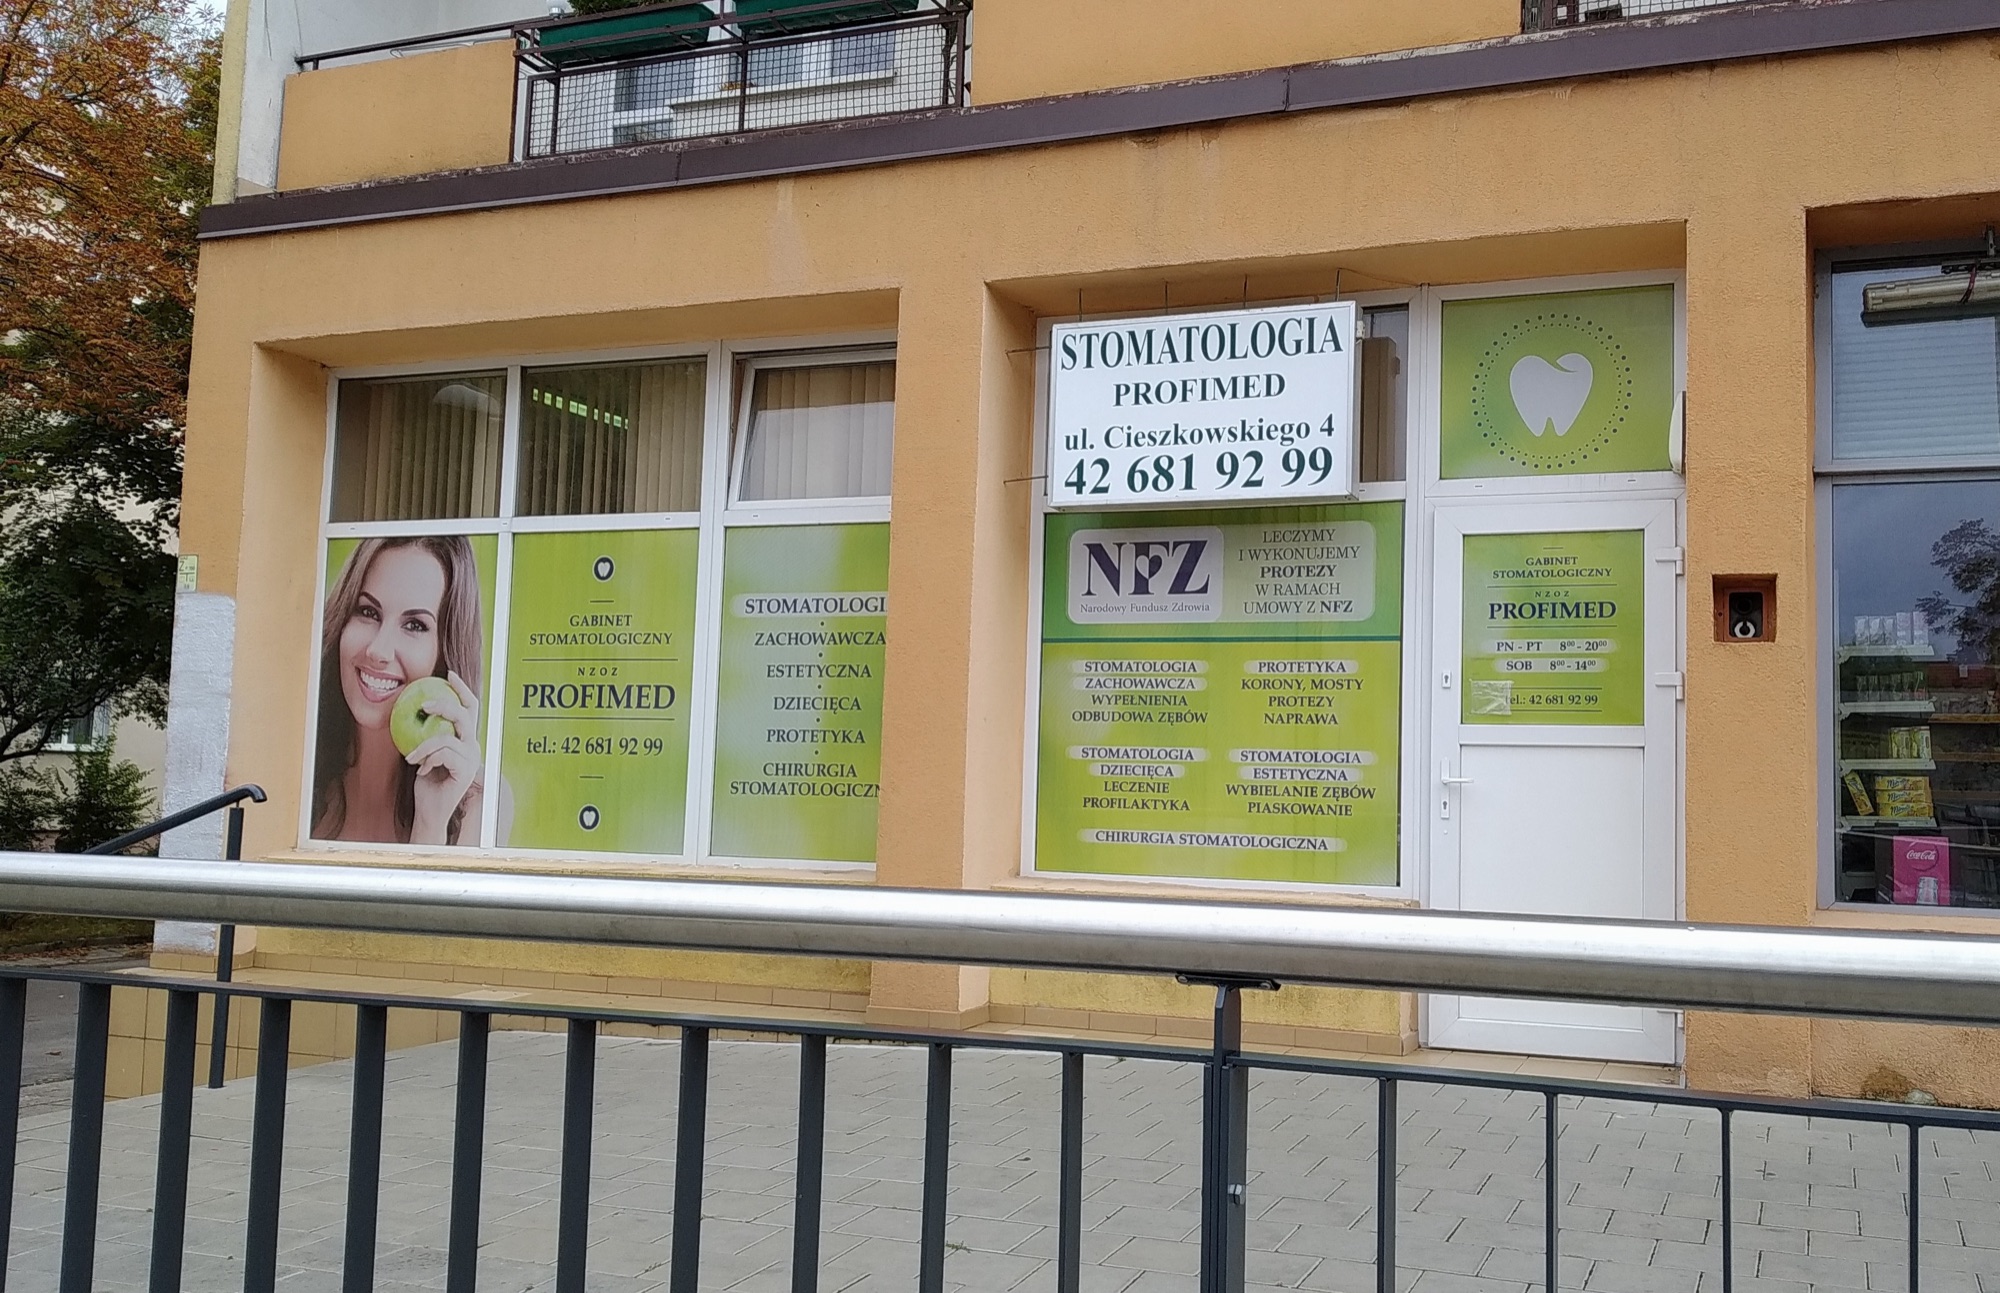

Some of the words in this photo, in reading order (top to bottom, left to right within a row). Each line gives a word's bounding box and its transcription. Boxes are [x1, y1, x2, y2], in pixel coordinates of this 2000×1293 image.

[1061, 315, 1344, 371] STOMATOLOGIA
[1113, 373, 1286, 407] PROFIMED
[1065, 428, 1095, 450] ul.
[1104, 418, 1310, 449] Cieszkowskiego
[1319, 413, 1335, 438] 4
[1064, 458, 1111, 495] 42
[1127, 453, 1198, 494] 681
[1215, 450, 1265, 490] 92
[1281, 446, 1334, 487] 99
[1262, 529, 1336, 543] LECZYMY
[1238, 549, 1244, 561] I
[1247, 546, 1361, 561] WYKONUJEMY
[1081, 540, 1210, 597] NFZ
[1525, 556, 1578, 567] GABINET
[1260, 564, 1337, 579] PROTEZY
[1492, 568, 1613, 579] STOMATOLOGICZNY
[1255, 583, 1270, 596] W
[1273, 582, 1341, 596] RAMACH
[745, 597, 888, 615] STOMATOLOGI
[1080, 602, 1127, 615] Narodowy
[1130, 602, 1169, 613] Fundusz
[1171, 602, 1210, 613] Zdrowia
[1243, 600, 1303, 615] UMOWY
[1306, 601, 1316, 613] Z
[1319, 600, 1354, 614] NFZ
[1488, 601, 1617, 620] PROFIMED
[569, 614, 633, 628] GABINET
[529, 632, 673, 646] STOMATOLOGICZNY
[754, 631, 887, 646] ZACHOWAWCZA
[1496, 641, 1514, 652] PN
[1526, 641, 1543, 651] PT
[766, 664, 872, 679] ESTETYCZNA
[1084, 660, 1197, 673] STOMATOLOGIA
[1258, 661, 1347, 673] PROTETYKA
[1506, 660, 1533, 671] SOB
[1085, 677, 1196, 690] ZACHOWAWCZA
[1241, 678, 1306, 693] KORONY,
[1310, 678, 1364, 691] MOSTY
[521, 684, 676, 710] PROFIMED
[1091, 694, 1188, 706] WYPEŁNIENIA
[1268, 695, 1335, 708] PROTEZY
[1528, 695, 1543, 706] 42
[1545, 694, 1564, 706] 681
[1568, 694, 1582, 706] 92
[1584, 694, 1599, 706] 99
[773, 696, 862, 715] DZIECIĘCA
[1071, 710, 1155, 724] ODBUDOWA
[1157, 709, 1208, 726] ZĘBÓW
[1263, 712, 1338, 725] NAPRAWA
[766, 729, 866, 744] PROTETYKA
[560, 736, 581, 755] 42
[585, 736, 612, 756] 681
[618, 737, 638, 756] 92
[643, 737, 664, 757] 99
[1081, 747, 1194, 761] STOMATOLOGIA
[1240, 750, 1361, 765] STOMATOLOGIA
[763, 762, 857, 778] CHIRURGIA
[1100, 764, 1174, 779] DZIECIĘCA
[1252, 768, 1348, 782] ESTETYCZNA
[1103, 781, 1170, 794] LECZENIE
[1225, 783, 1318, 798] WYBIELANIE
[1322, 783, 1376, 802] ZĘBÓW
[1082, 797, 1190, 811] PROFILAKTYKA
[1247, 801, 1353, 817] PIASKOWANIE
[1095, 830, 1175, 845] CHIRURGIA
[1179, 834, 1328, 851] STOMATOLOGICZNA
